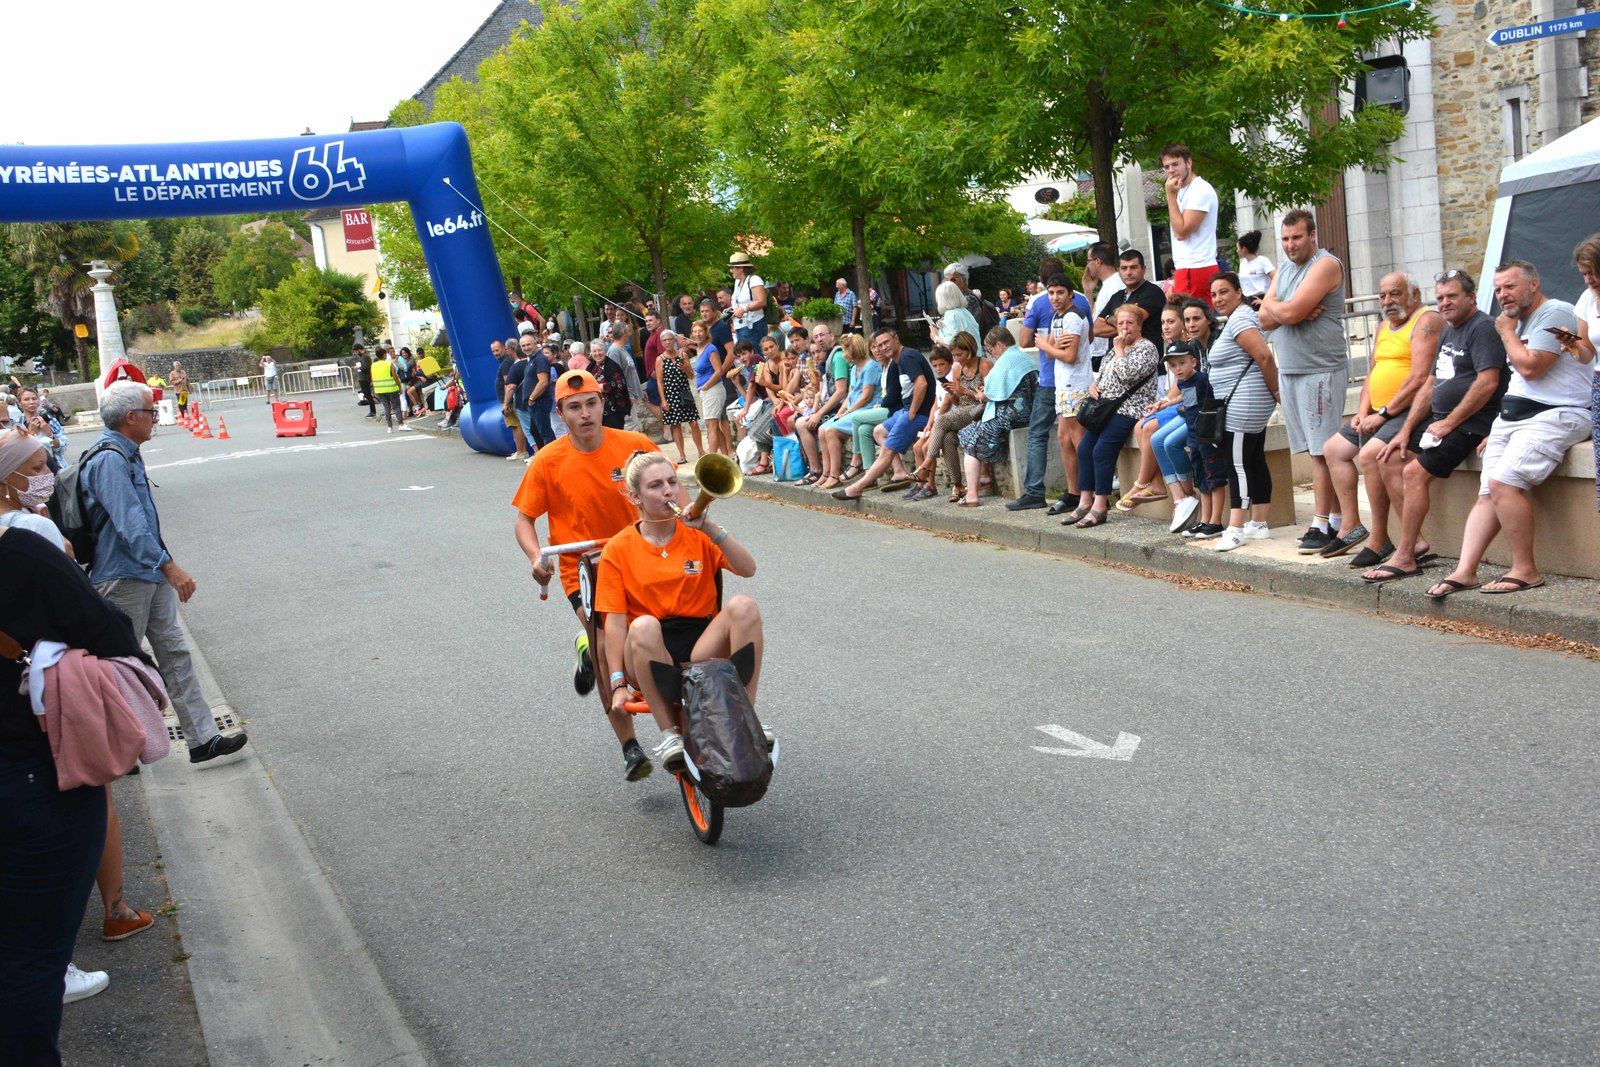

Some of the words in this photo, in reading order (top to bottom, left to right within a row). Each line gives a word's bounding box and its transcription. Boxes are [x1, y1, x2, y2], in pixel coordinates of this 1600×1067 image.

[1500, 25, 1542, 41] DUBLIN
[1549, 22, 1567, 32] 1175
[1570, 21, 1582, 29] km
[289, 140, 366, 201] 64
[114, 187, 140, 202] LE
[143, 180, 284, 201] DÉPARTEMENT
[345, 212, 369, 226] BAR
[426, 210, 483, 237] le64.fr
